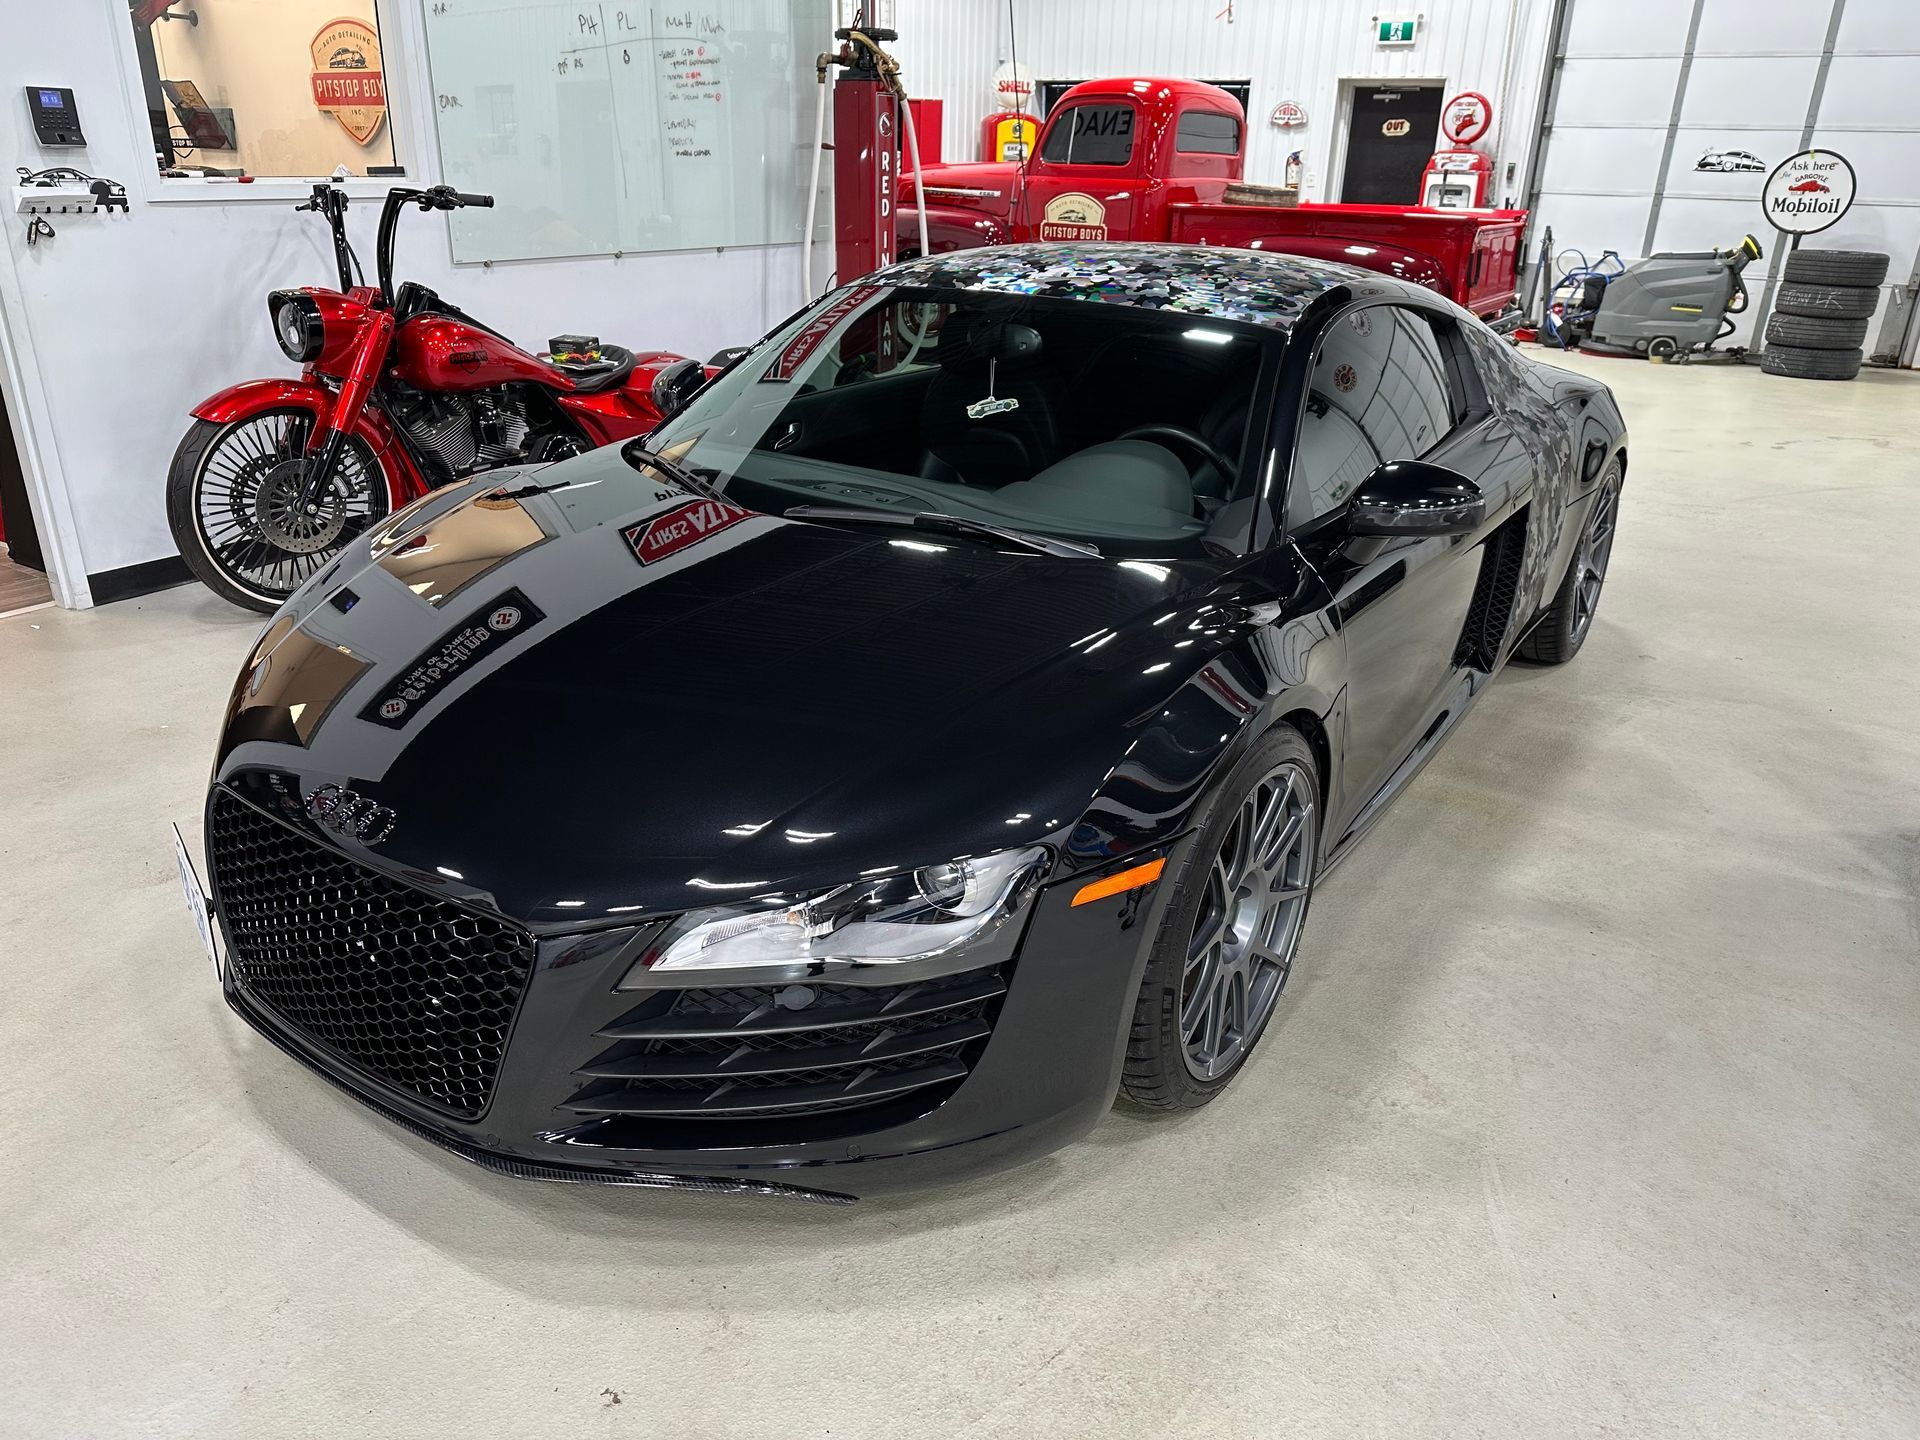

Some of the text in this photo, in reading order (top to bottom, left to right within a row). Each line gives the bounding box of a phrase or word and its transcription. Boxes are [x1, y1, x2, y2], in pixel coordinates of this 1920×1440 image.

[578, 14, 598, 35] PH
[617, 11, 636, 31] PL
[323, 31, 371, 47] AUTO DETAILING
[316, 78, 384, 98] PITSTOP BOY
[998, 80, 1031, 94] SHELL
[1386, 121, 1405, 131] OUT
[1790, 160, 1838, 171] Ask here
[881, 151, 890, 217] RED
[1795, 173, 1829, 183] GARGOYLE
[1771, 196, 1841, 214] Mobiloil
[1044, 225, 1103, 241] PITSTOP BOYS
